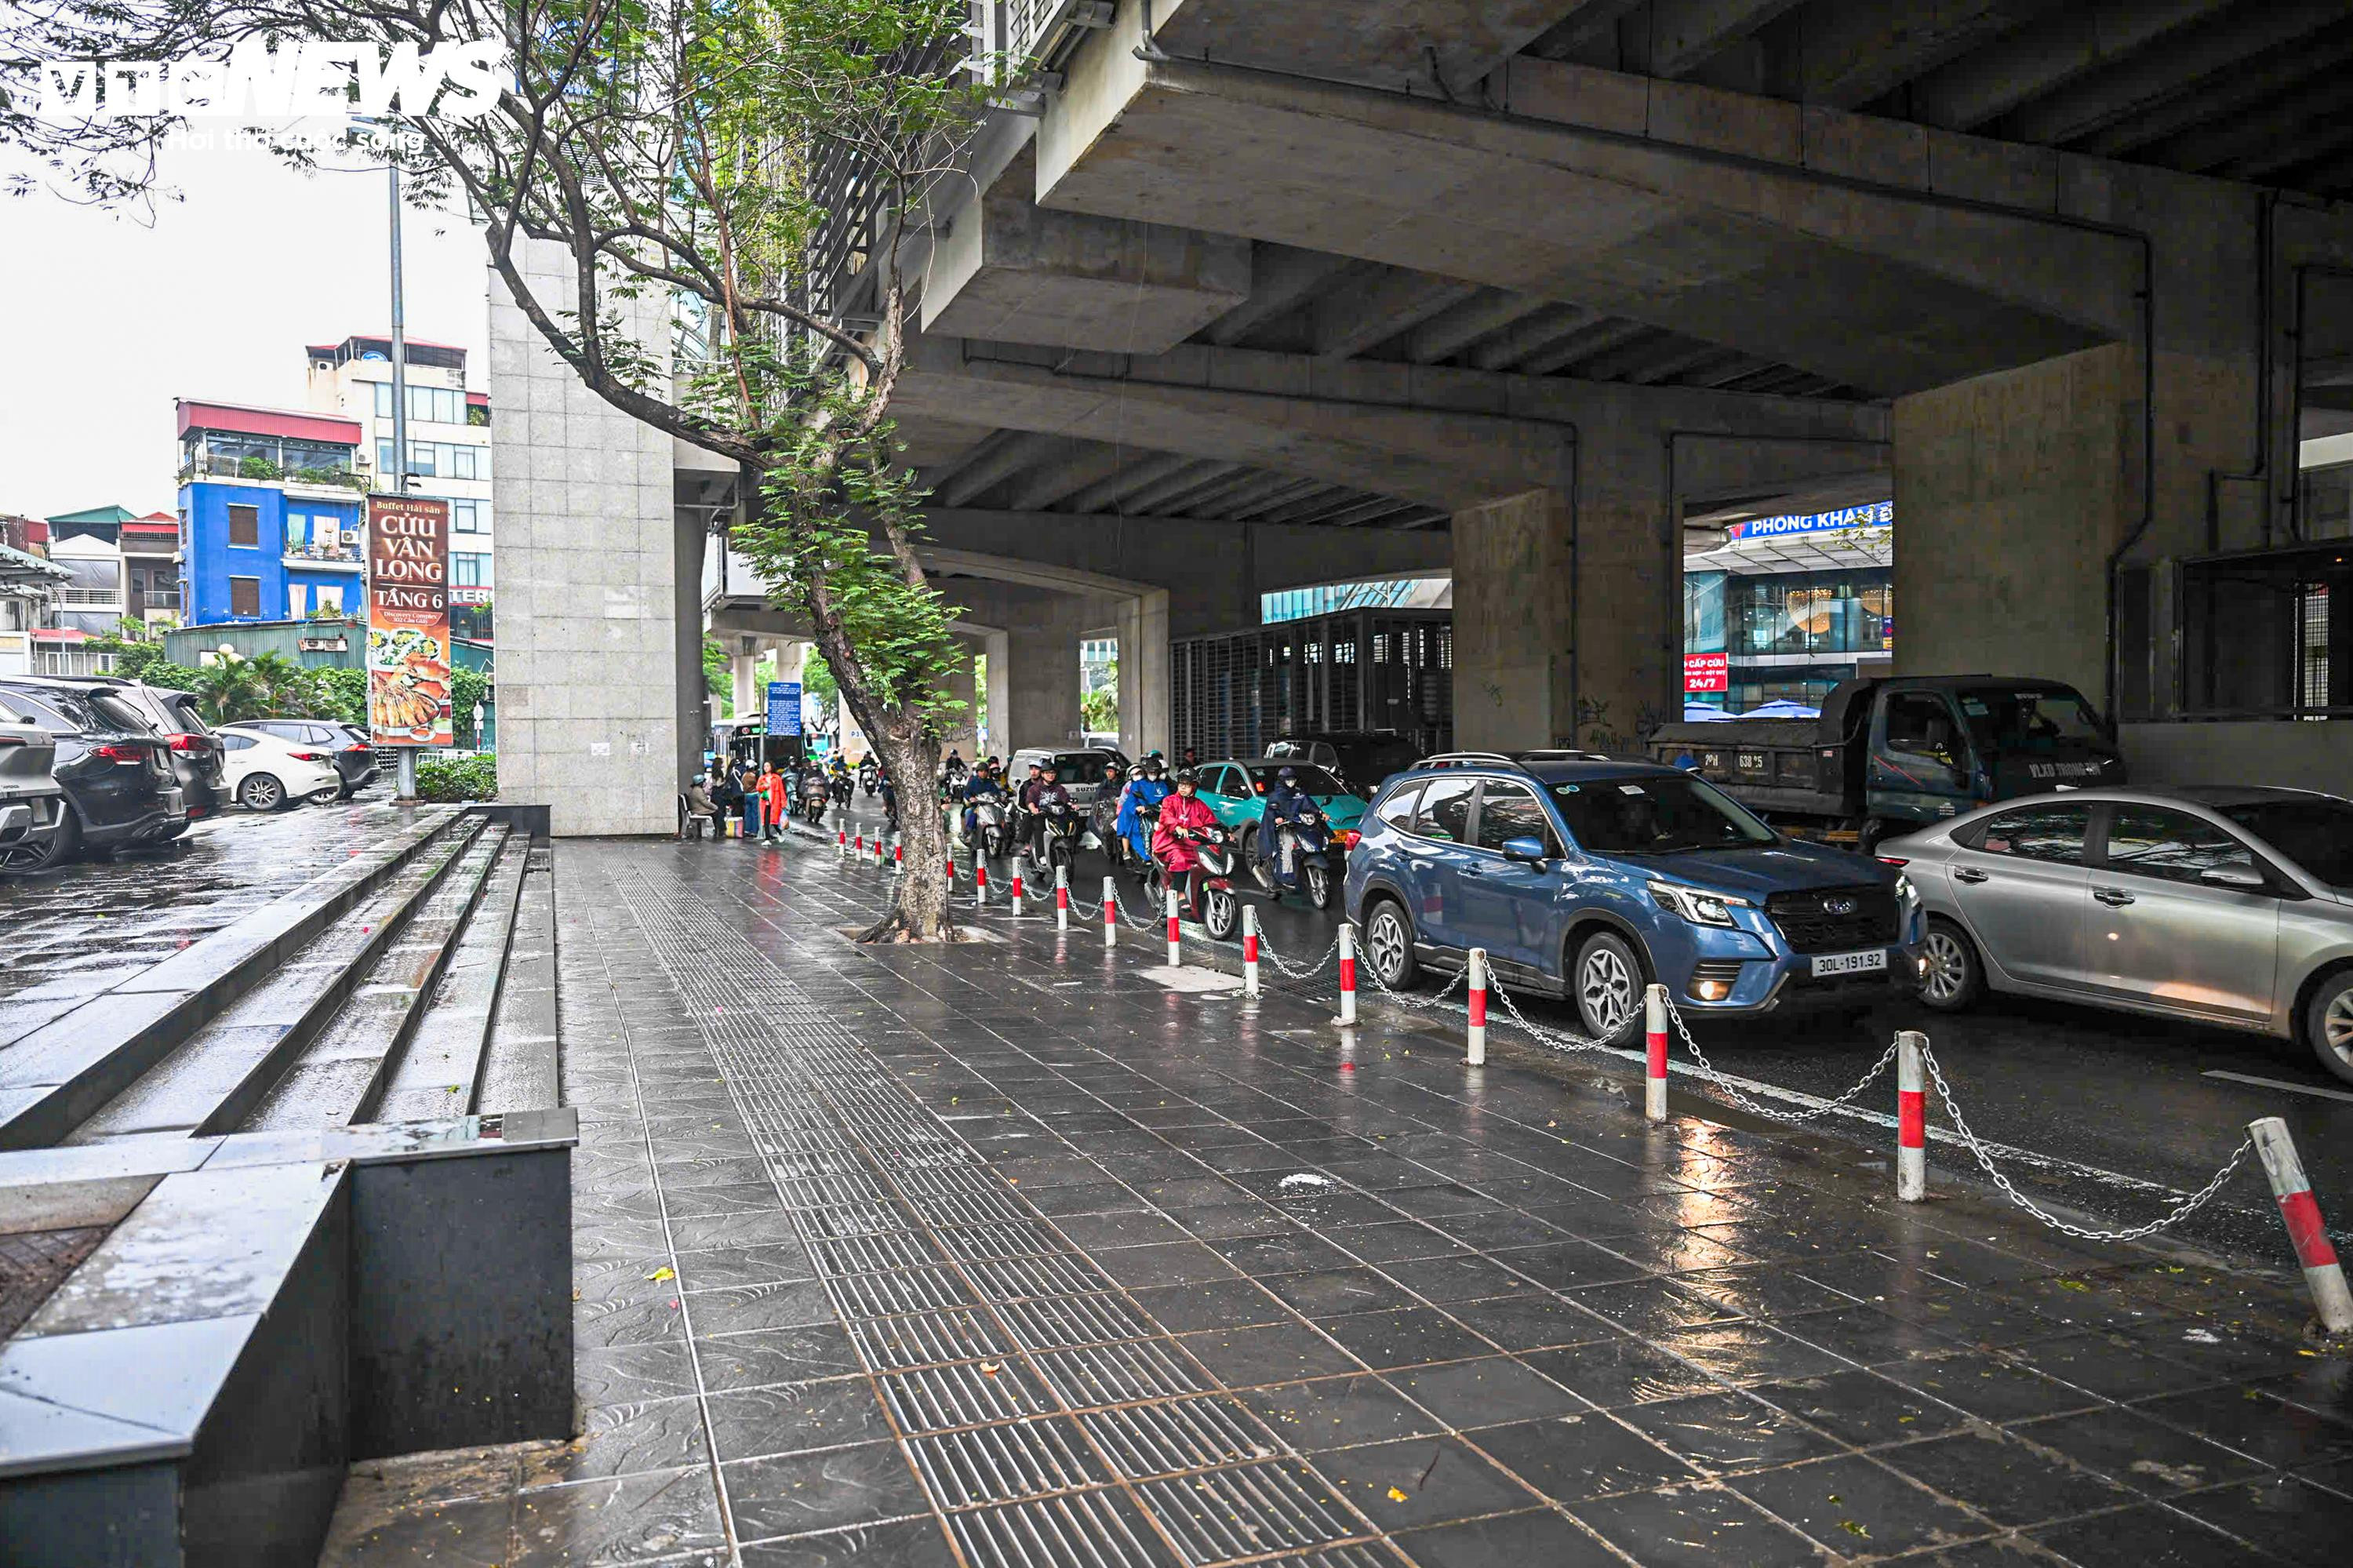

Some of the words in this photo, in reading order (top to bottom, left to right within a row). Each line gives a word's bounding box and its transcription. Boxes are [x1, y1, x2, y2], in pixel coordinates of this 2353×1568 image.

[376, 500, 404, 511] Buffet
[380, 512, 437, 538] CỬU
[381, 536, 434, 560] VÂN
[376, 558, 442, 582] LONG
[432, 594, 443, 609] 6
[1689, 678, 1715, 689] 24/7
[1819, 953, 1881, 972] 30L-191.92
